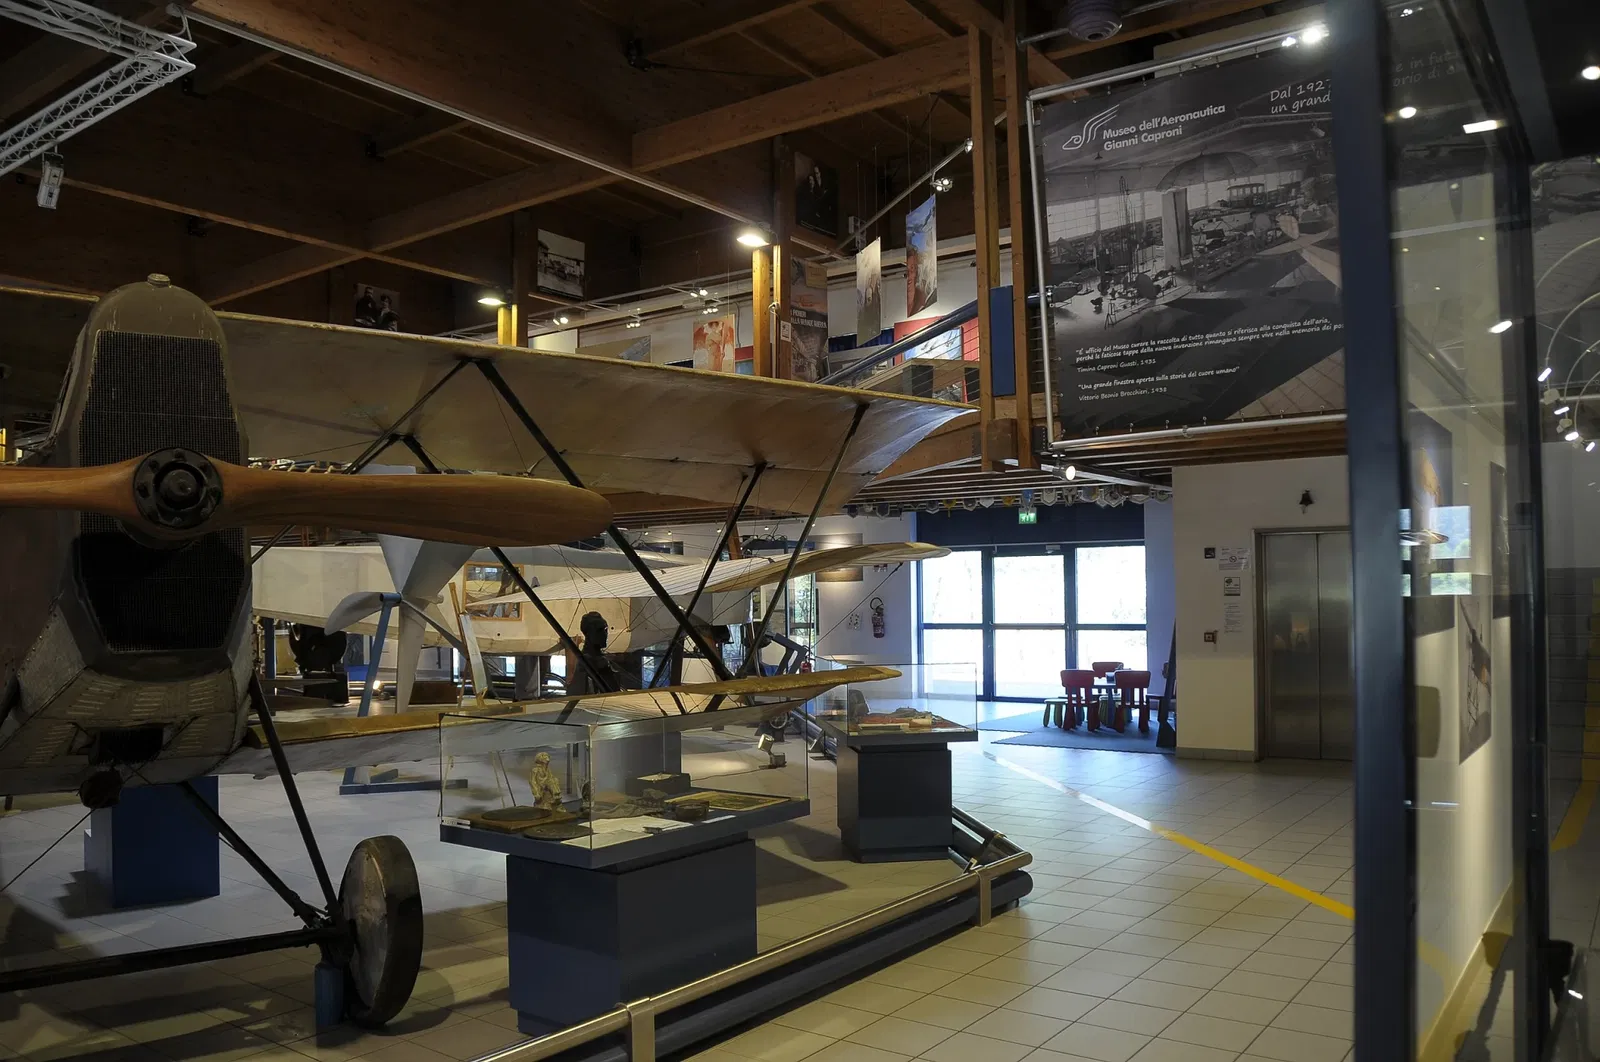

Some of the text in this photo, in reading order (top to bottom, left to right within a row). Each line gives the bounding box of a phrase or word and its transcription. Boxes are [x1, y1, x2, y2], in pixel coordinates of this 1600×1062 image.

[1270, 86, 1291, 102] Dal
[1271, 104, 1288, 114] un
[1103, 104, 1226, 140] Museo dell'Aeronautica
[1104, 125, 1182, 150] Gianni Caproni
[1205, 332, 1226, 340] quanto
[1272, 322, 1301, 331] conquista
[1302, 318, 1330, 326] dell'aria,
[1076, 355, 1094, 363] perché
[1204, 338, 1237, 346] rimangano
[1292, 326, 1320, 334] memoria
[1096, 362, 1118, 371] Caproni
[1093, 381, 1112, 390] grande
[1079, 393, 1100, 401] Vittorio
